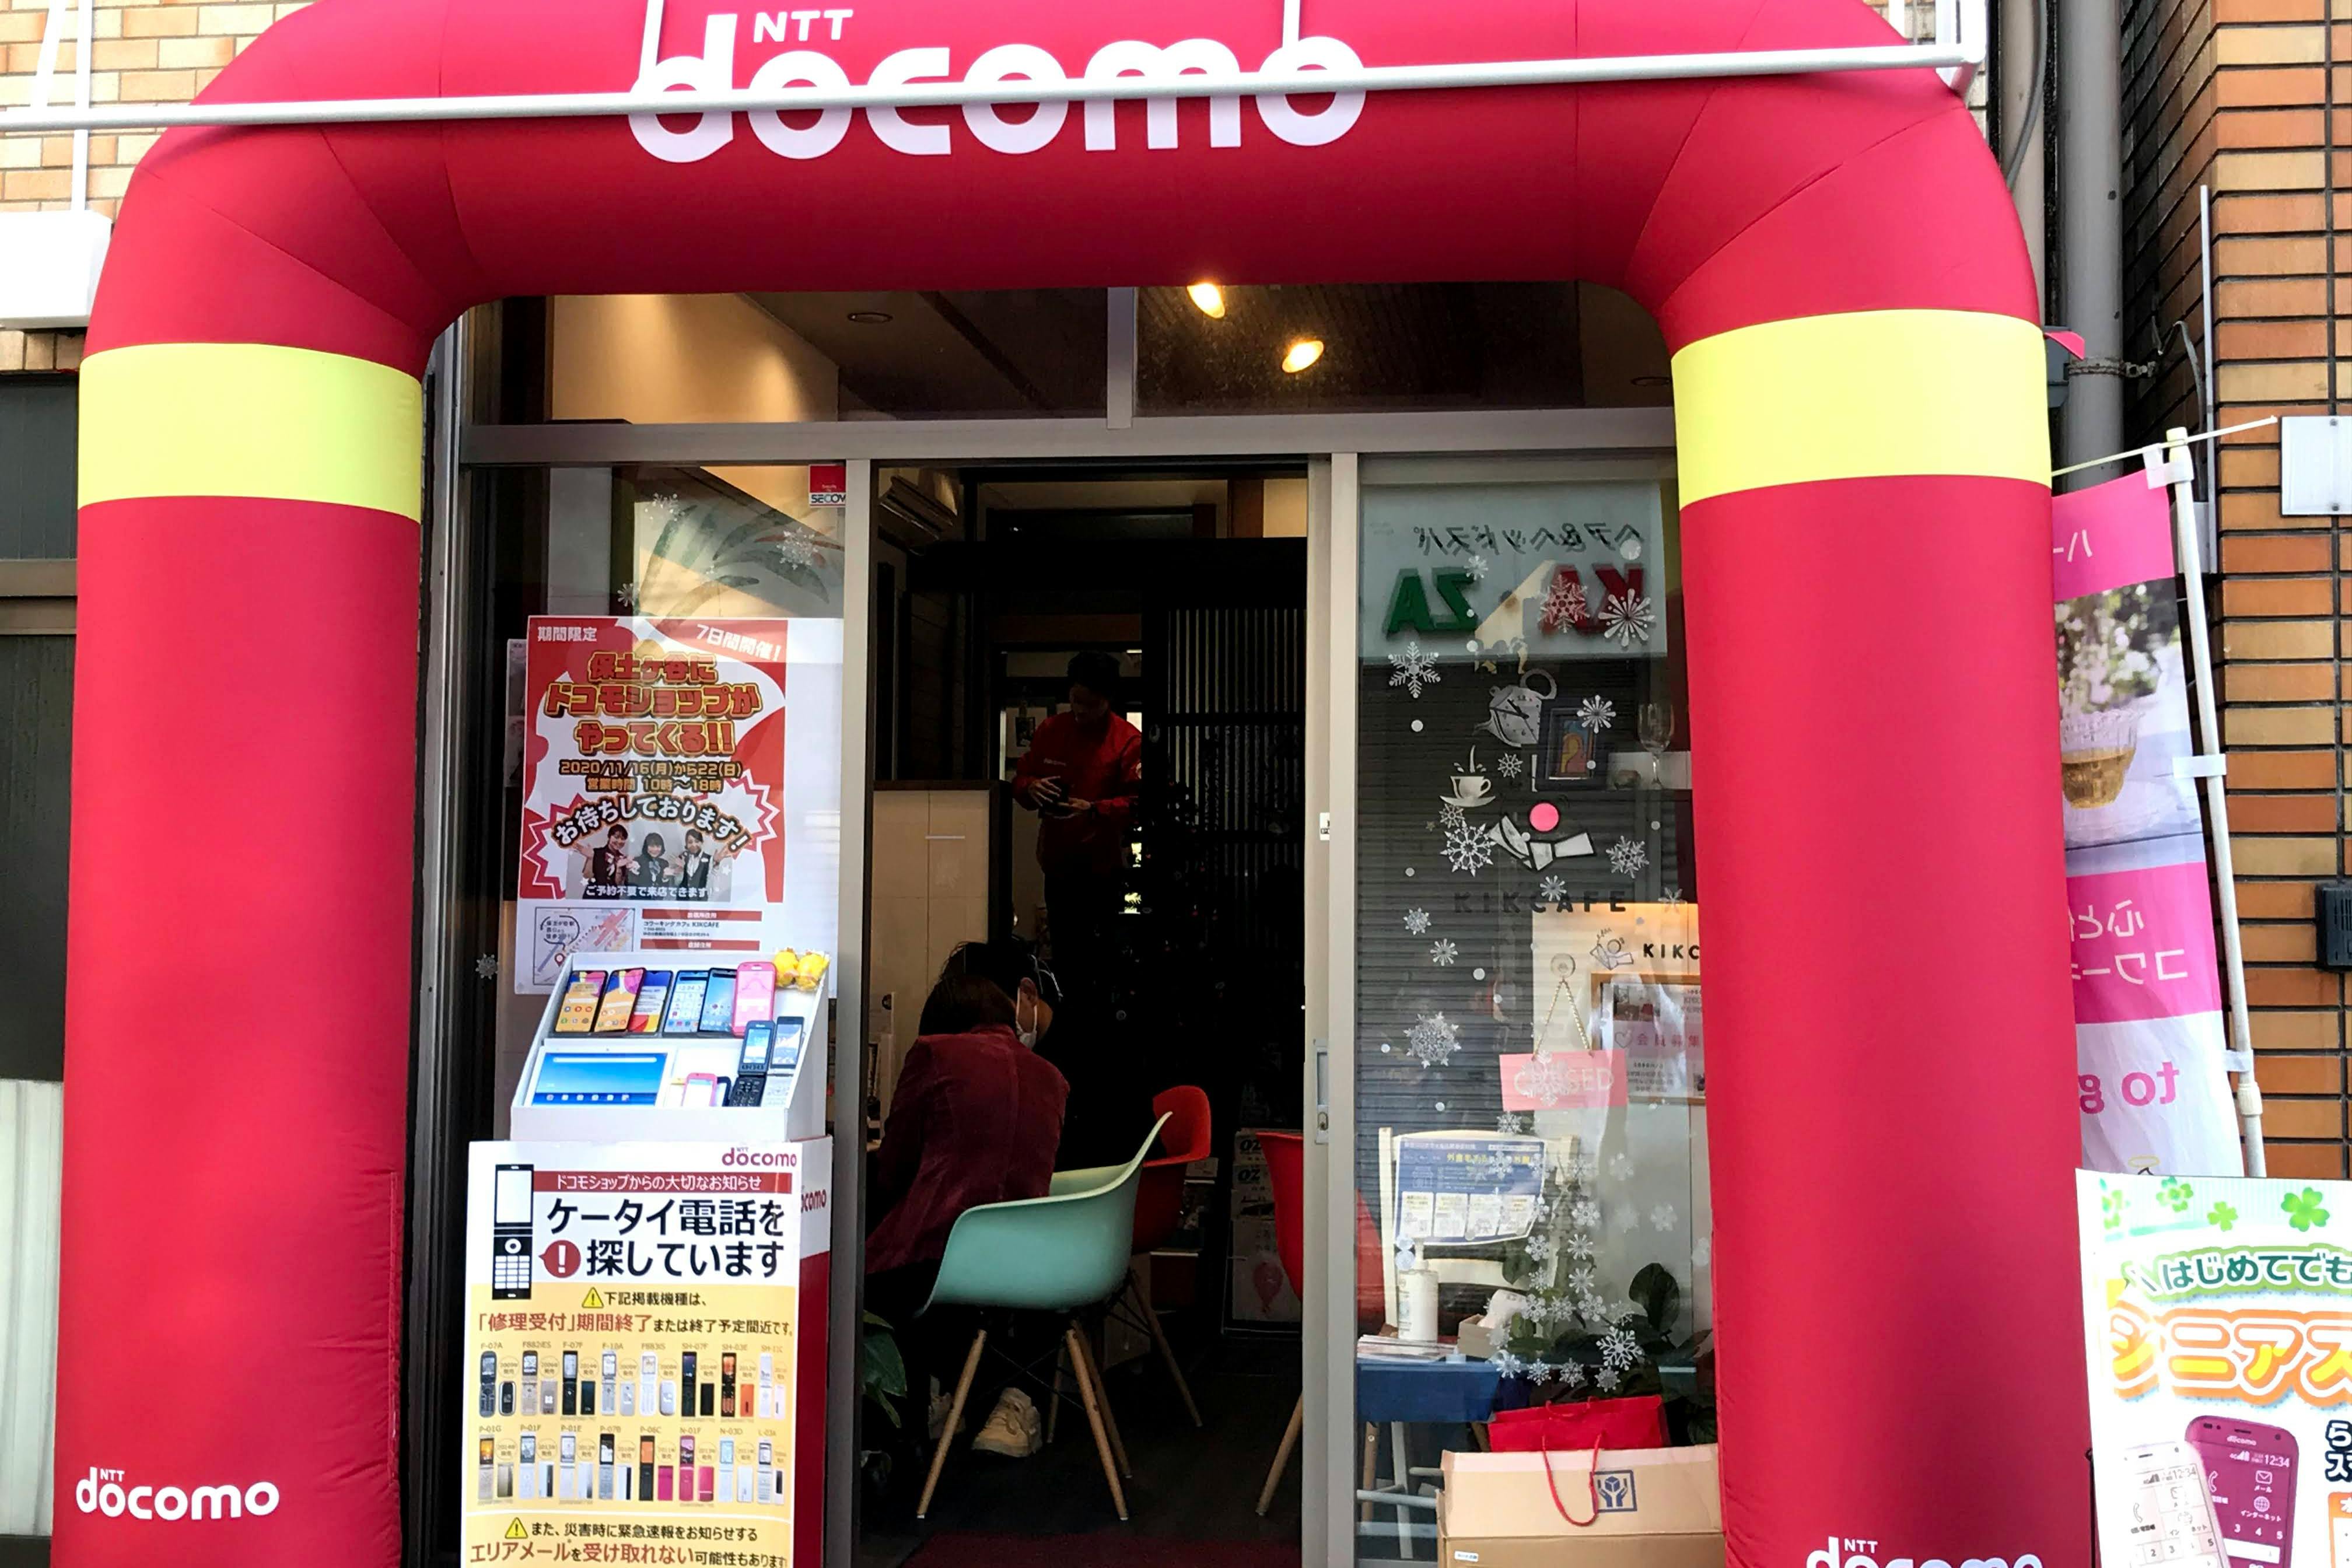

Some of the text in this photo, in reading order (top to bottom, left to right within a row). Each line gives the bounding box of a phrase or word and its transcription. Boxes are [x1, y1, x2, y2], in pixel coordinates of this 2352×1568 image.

[754, 9, 853, 43] NTT
[628, 13, 1366, 163] docomo
[538, 626, 596, 642] 期間限定
[696, 624, 779, 662] 7日間開催!
[544, 684, 762, 716] ドコモショップが
[575, 721, 735, 754] やってくる!!
[560, 761, 741, 776] 2020/11/16(月)から22(日)
[587, 778, 636, 791] 営業時間
[555, 797, 751, 850] お待ちしております!
[1454, 891, 1626, 913] KIKCAFE
[722, 1147, 797, 1167] docomo
[557, 1174, 762, 1191] ドコモショップからの大切なお知らせ
[547, 1198, 785, 1237] ケータイ電話を
[586, 1239, 785, 1278] 探しています
[2162, 1252, 2352, 1291] はじめてでも
[604, 1291, 708, 1307] 下記掲載機種は、
[2264, 1454, 2290, 1468] 12:34
[100, 1468, 124, 1482] NTT
[76, 1466, 279, 1521] docomo
[531, 1521, 758, 1542] また、災害時に緊急速報をお知らせする
[1844, 1538, 1878, 1554] NTT
